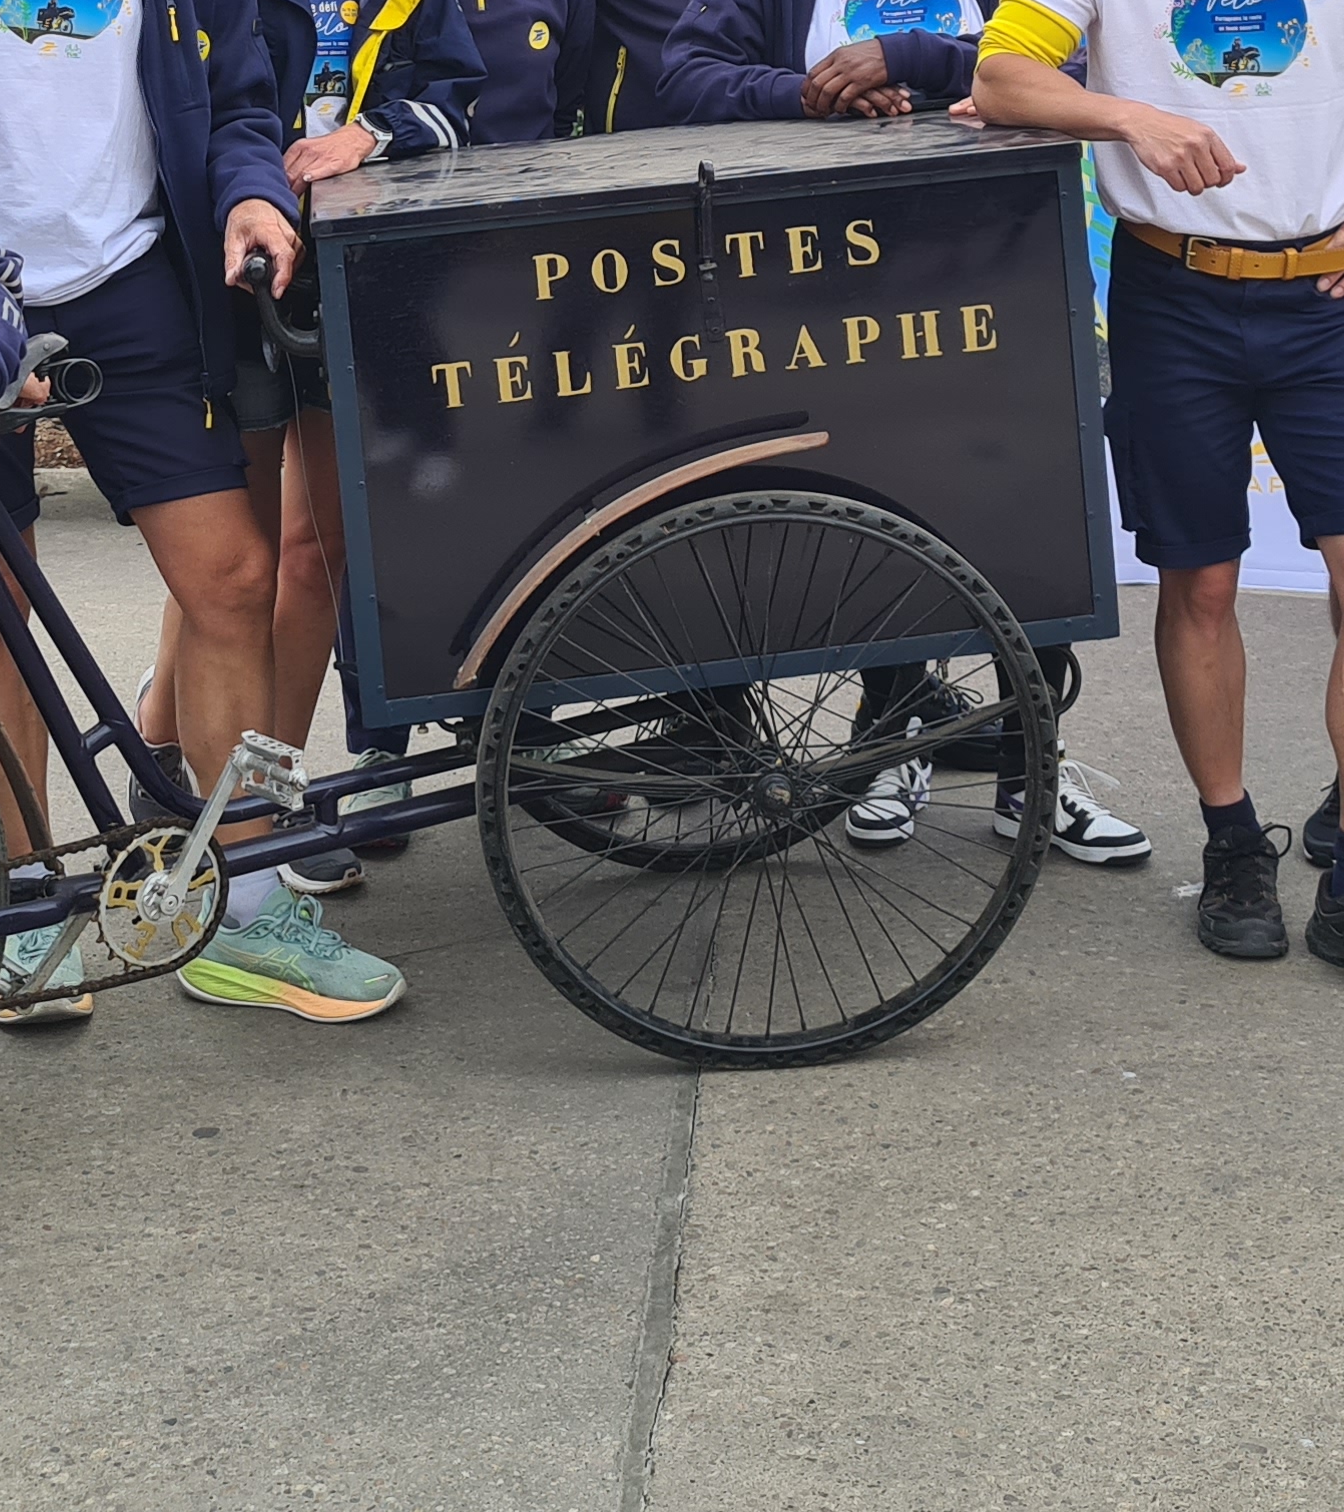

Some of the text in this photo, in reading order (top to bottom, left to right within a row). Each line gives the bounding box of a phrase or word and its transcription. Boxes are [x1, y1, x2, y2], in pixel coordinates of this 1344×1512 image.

[313, 13, 348, 35] élo
[531, 219, 882, 301] POSTES
[431, 304, 999, 409] TÉLÉGRAPHE
